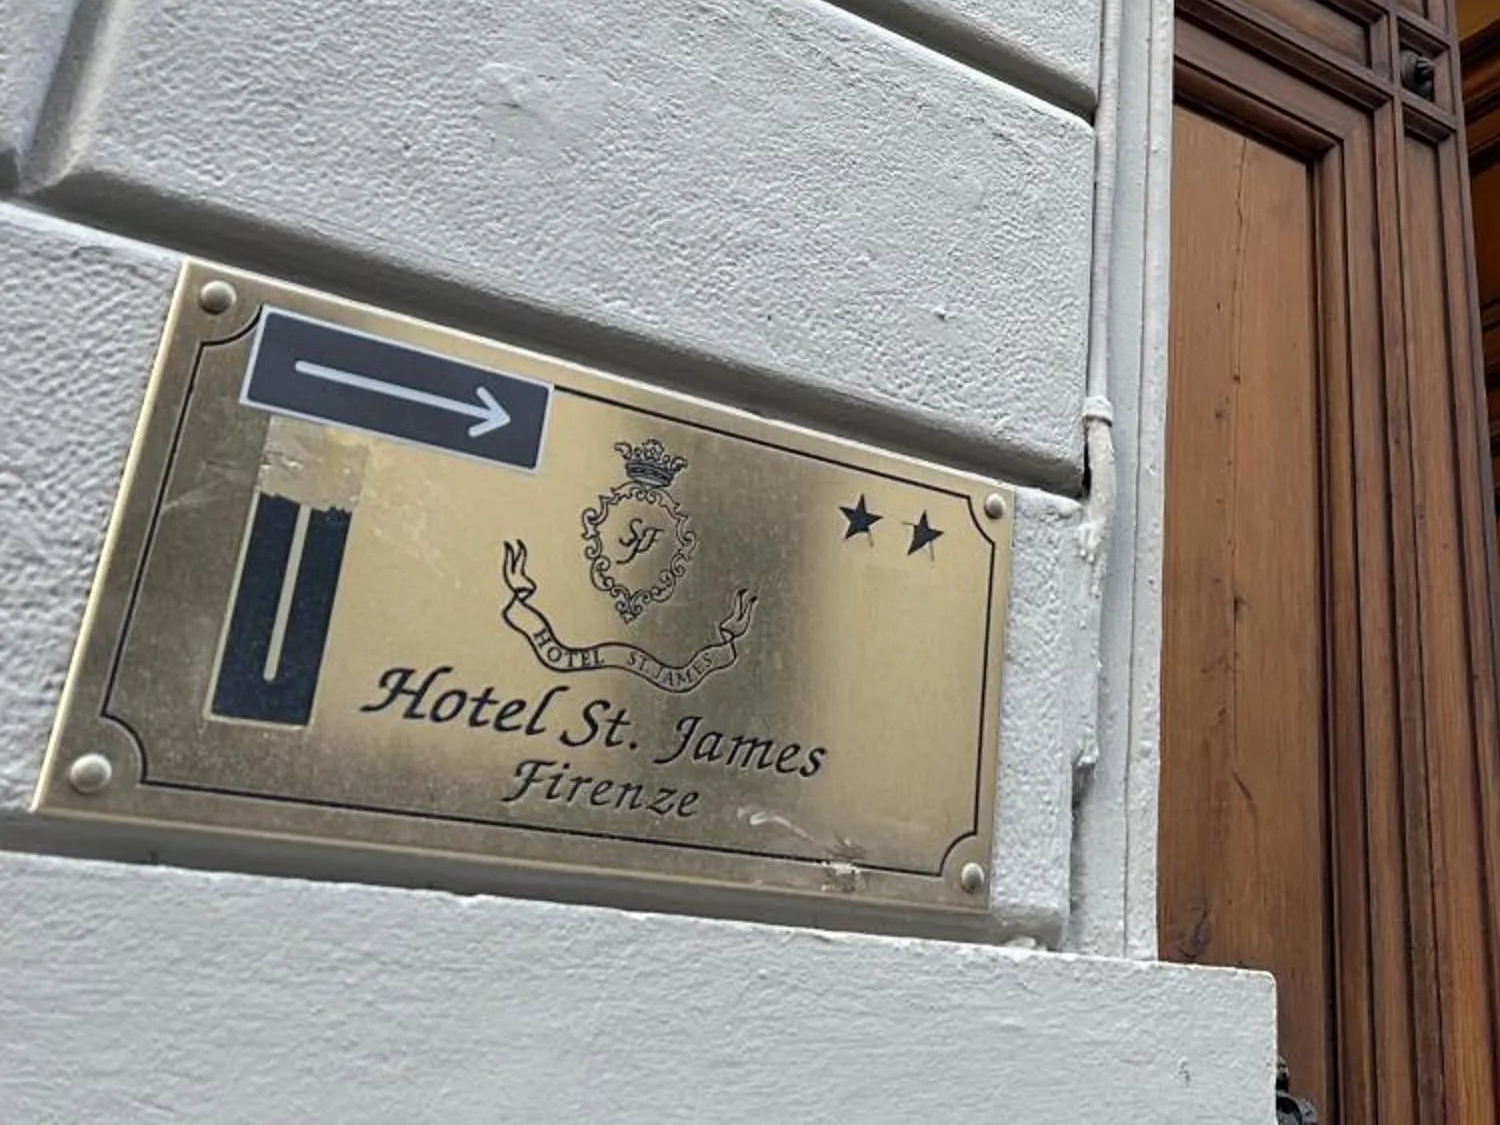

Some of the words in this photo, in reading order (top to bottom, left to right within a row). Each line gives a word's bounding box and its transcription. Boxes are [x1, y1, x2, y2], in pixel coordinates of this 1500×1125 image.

[533, 627, 605, 668] HOTEL
[654, 652, 714, 687] JAMES
[359, 665, 571, 736] Hotel
[559, 698, 638, 751] St.
[652, 715, 828, 778] James
[501, 759, 699, 818] Firenze
